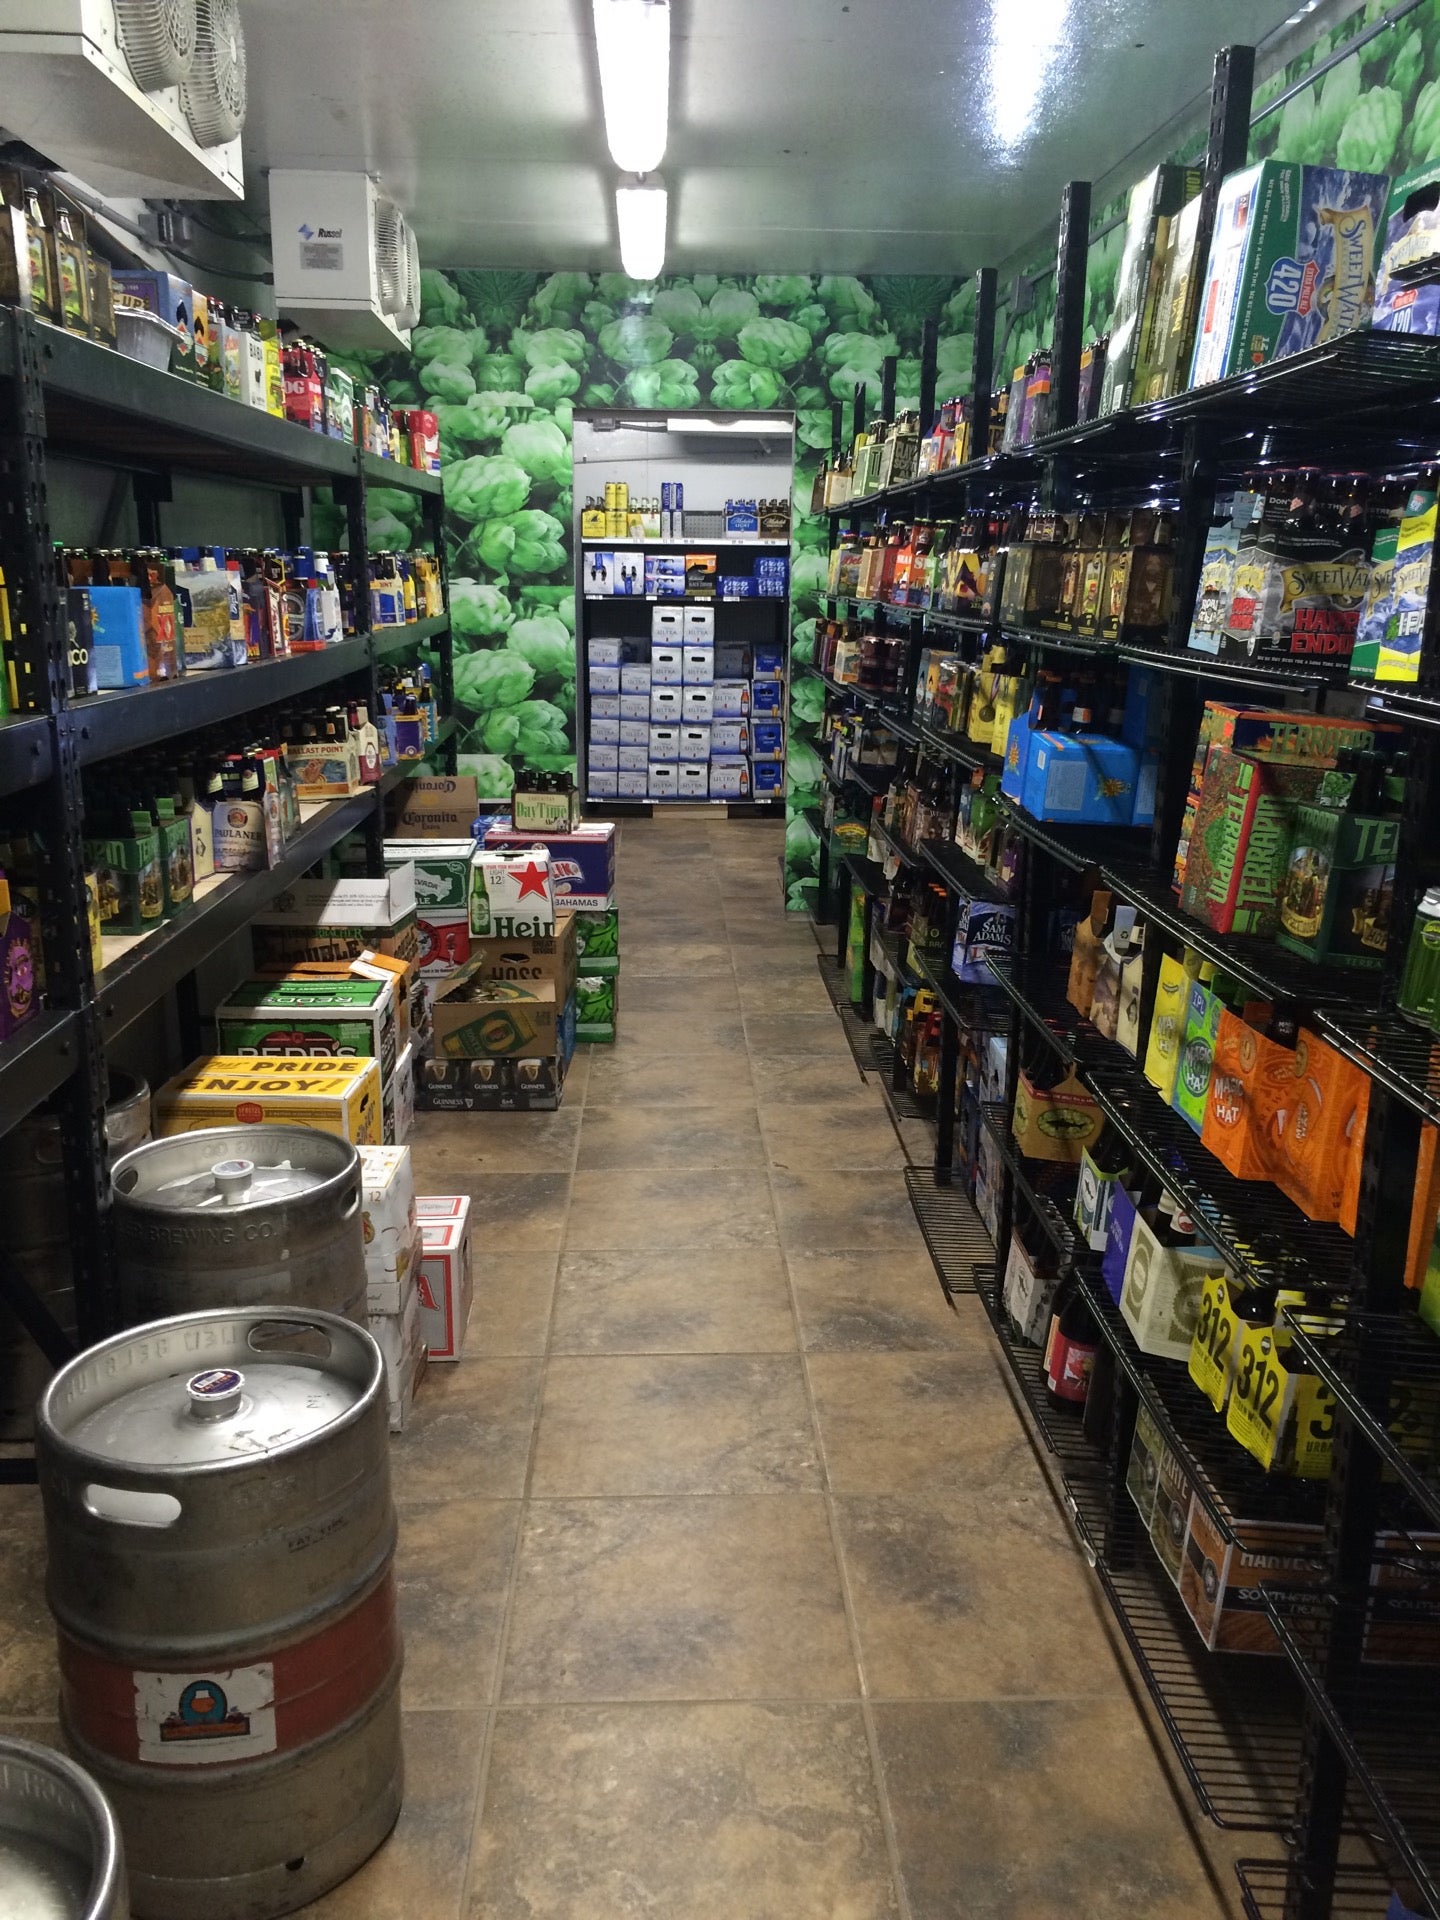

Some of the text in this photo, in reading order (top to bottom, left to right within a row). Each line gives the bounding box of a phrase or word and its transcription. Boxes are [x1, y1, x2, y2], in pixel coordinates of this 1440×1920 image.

[1269, 264, 1301, 308] 420
[1299, 267, 1315, 311] EXTRA PALE ALE
[1269, 497, 1291, 505] DON'
[1295, 608, 1361, 631] HAPP
[401, 812, 457, 827] Coronita
[490, 876, 502, 885] 12
[555, 899, 599, 907] BAHAMAS
[982, 921, 1007, 934] SAM
[973, 930, 1012, 944] ADAMS
[251, 1062, 358, 1072] PRIDE
[177, 1079, 346, 1093] ENJOY!
[1186, 1073, 1208, 1091] HAT
[1214, 1079, 1244, 1099] MAGIC
[1216, 1105, 1239, 1124] HAT
[368, 1192, 381, 1203] 12
[150, 1227, 235, 1245] BREWING
[1197, 1293, 1232, 1374] 312
[1237, 1344, 1280, 1431] 312
